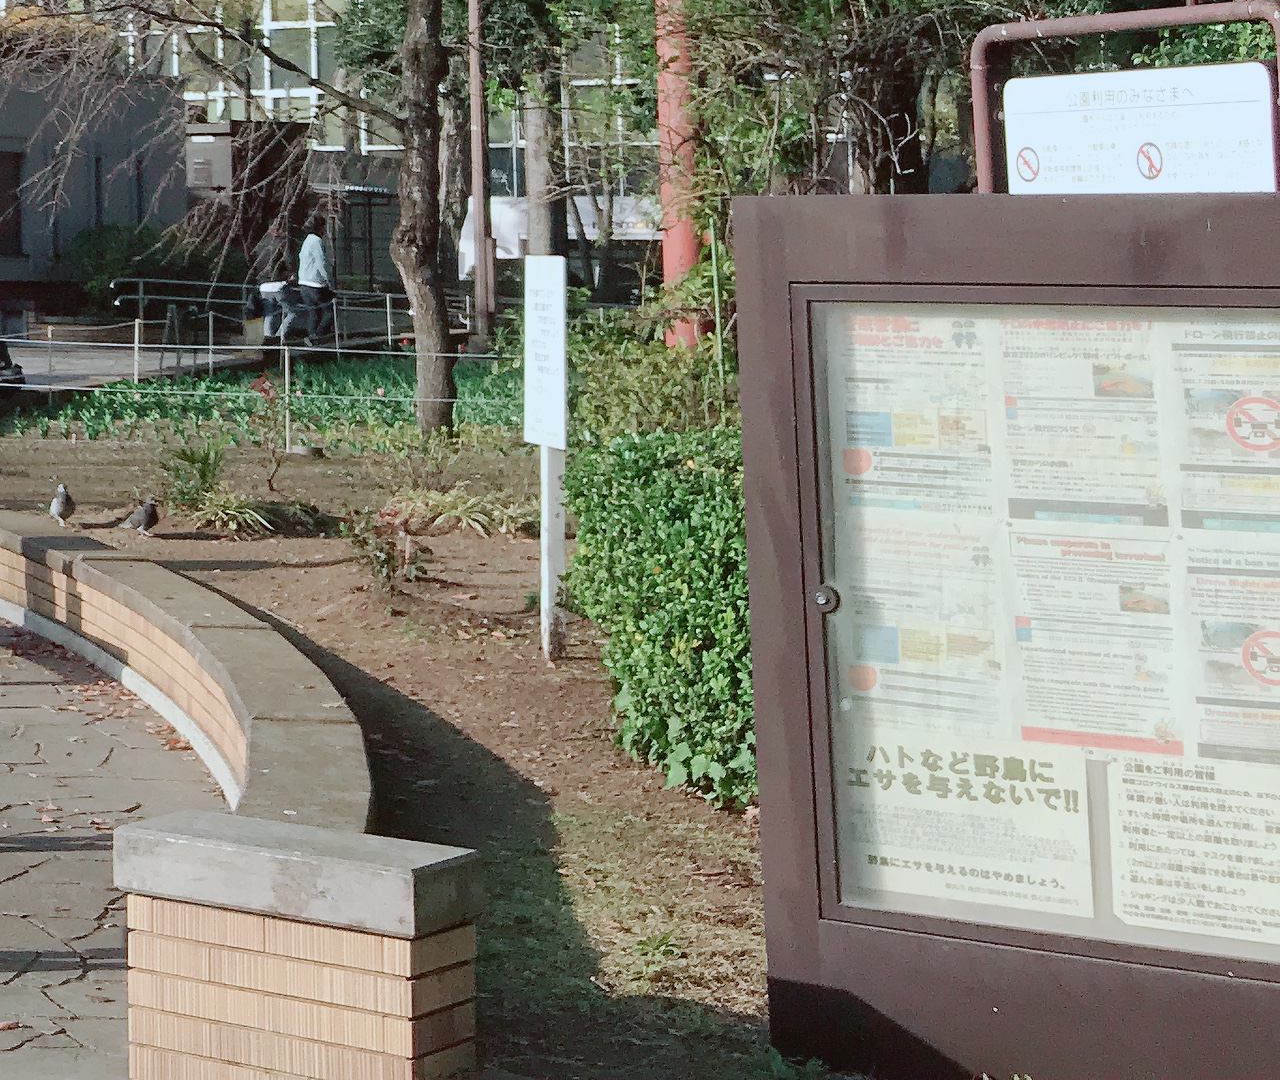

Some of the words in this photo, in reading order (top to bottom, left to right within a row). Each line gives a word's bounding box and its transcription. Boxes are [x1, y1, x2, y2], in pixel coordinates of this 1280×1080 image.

[1067, 86, 1194, 108] 公園利用のみなさまへ
[866, 745, 1055, 783] ハトなど野鳥に
[1123, 762, 1217, 782] 公園をご利用の皆様
[867, 854, 1067, 890] 野鳥にエサを与えるのはやめましょう。
